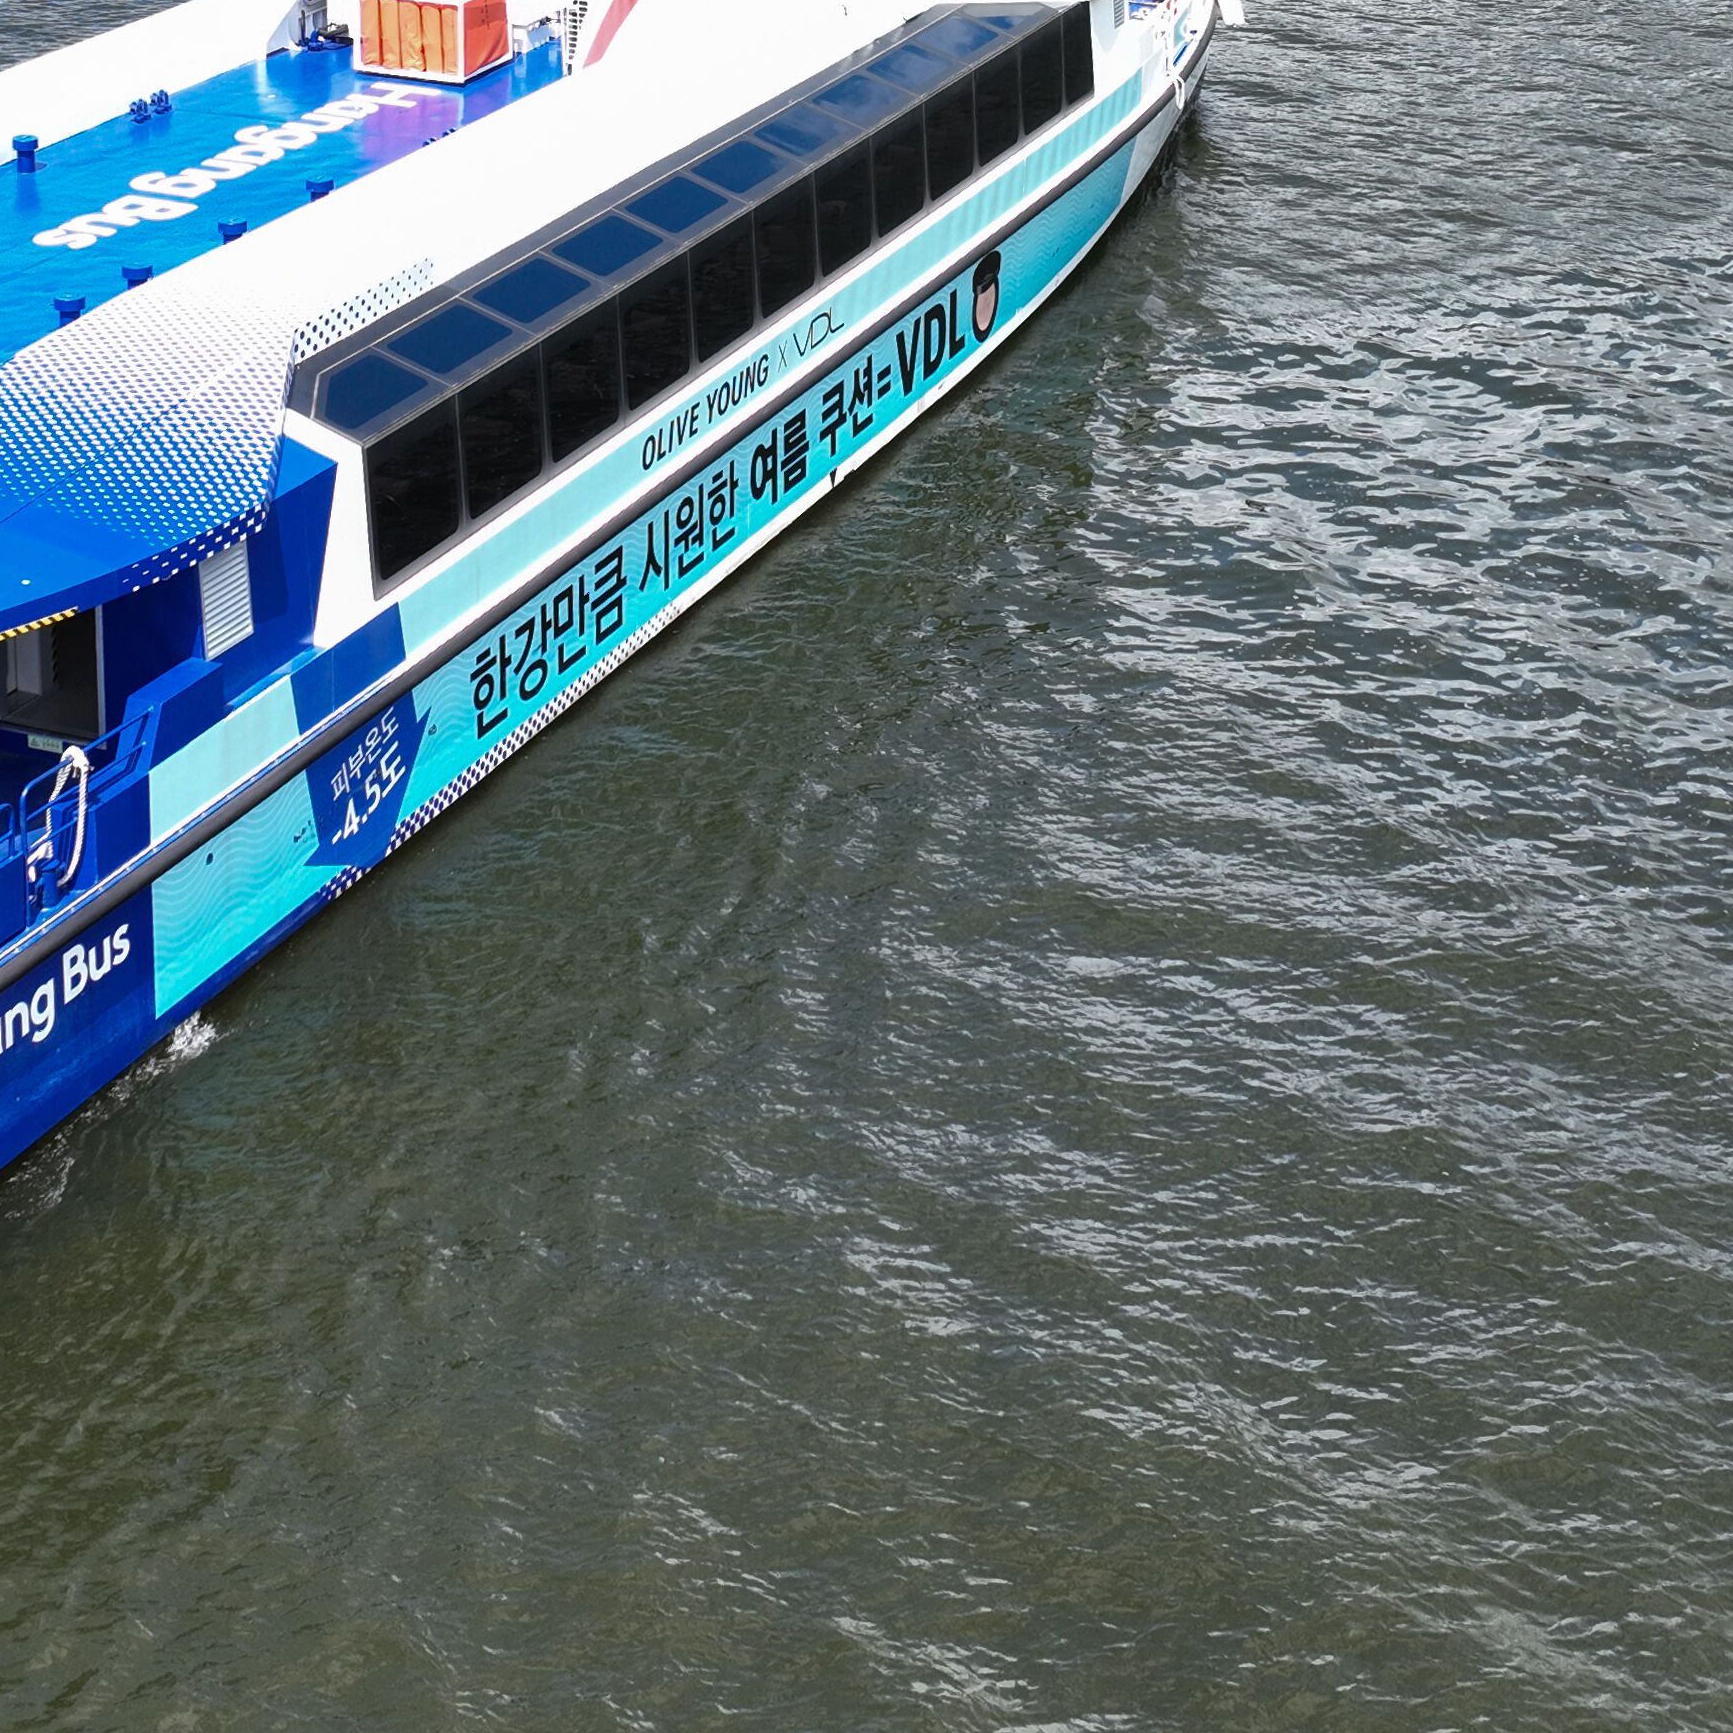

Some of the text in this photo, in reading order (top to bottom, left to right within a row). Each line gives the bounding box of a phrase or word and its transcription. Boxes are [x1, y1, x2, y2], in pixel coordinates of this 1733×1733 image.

[32, 82, 442, 250] Hangang Bus
[642, 401, 701, 471] OLIVE
[706, 353, 769, 424] YOUNG
[793, 306, 845, 357] VDL
[470, 544, 628, 740] 한강만큼
[638, 459, 740, 592] 시원한
[750, 408, 810, 506] 여름
[330, 706, 400, 802] 피부온도
[332, 740, 406, 845] -4.5도
[62, 922, 131, 1005] Bus
